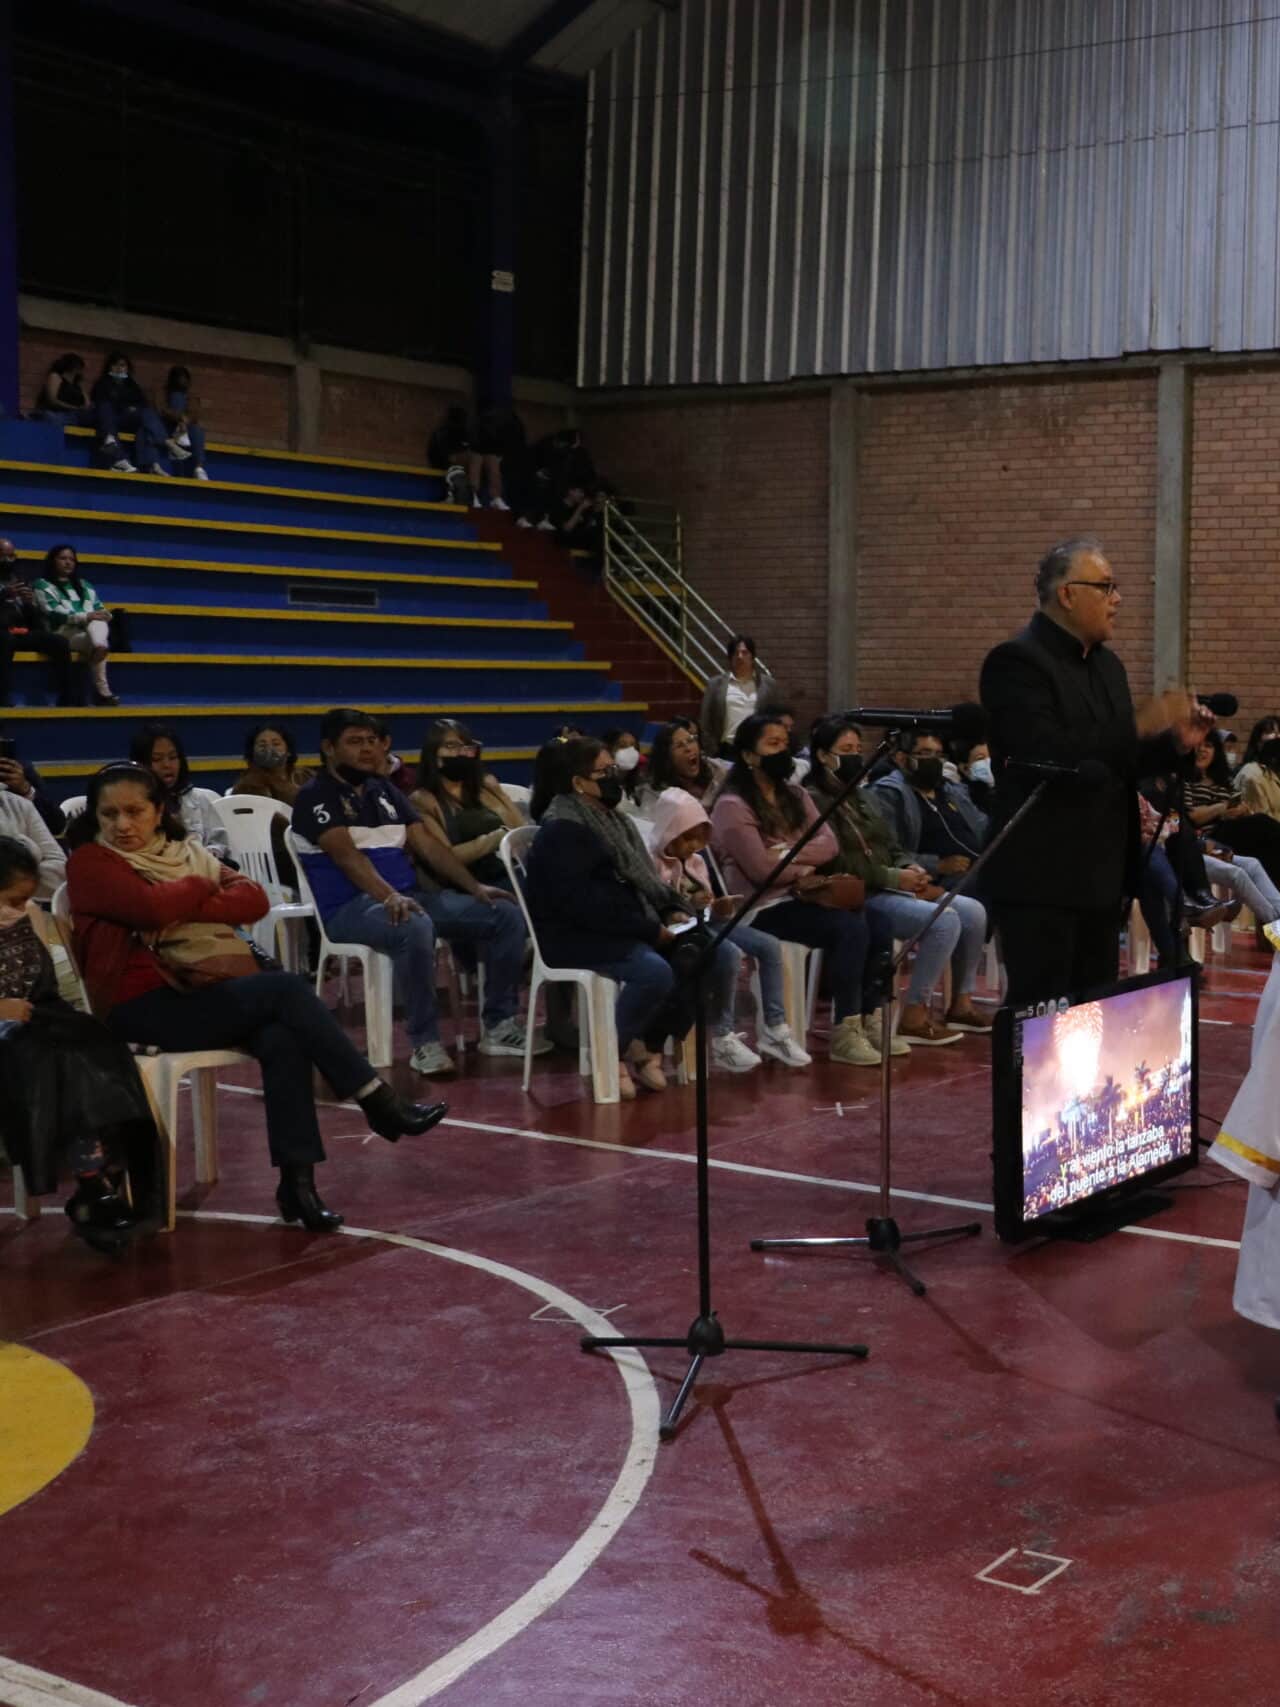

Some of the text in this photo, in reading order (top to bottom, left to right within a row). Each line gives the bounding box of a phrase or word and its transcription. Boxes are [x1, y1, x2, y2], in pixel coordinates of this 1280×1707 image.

[312, 802, 331, 824] 3
[1060, 1125, 1164, 1180] y al viento la lanzaba
[1050, 1176, 1068, 1202] del
[1069, 1167, 1106, 1197] puente
[1117, 1159, 1128, 1175] la
